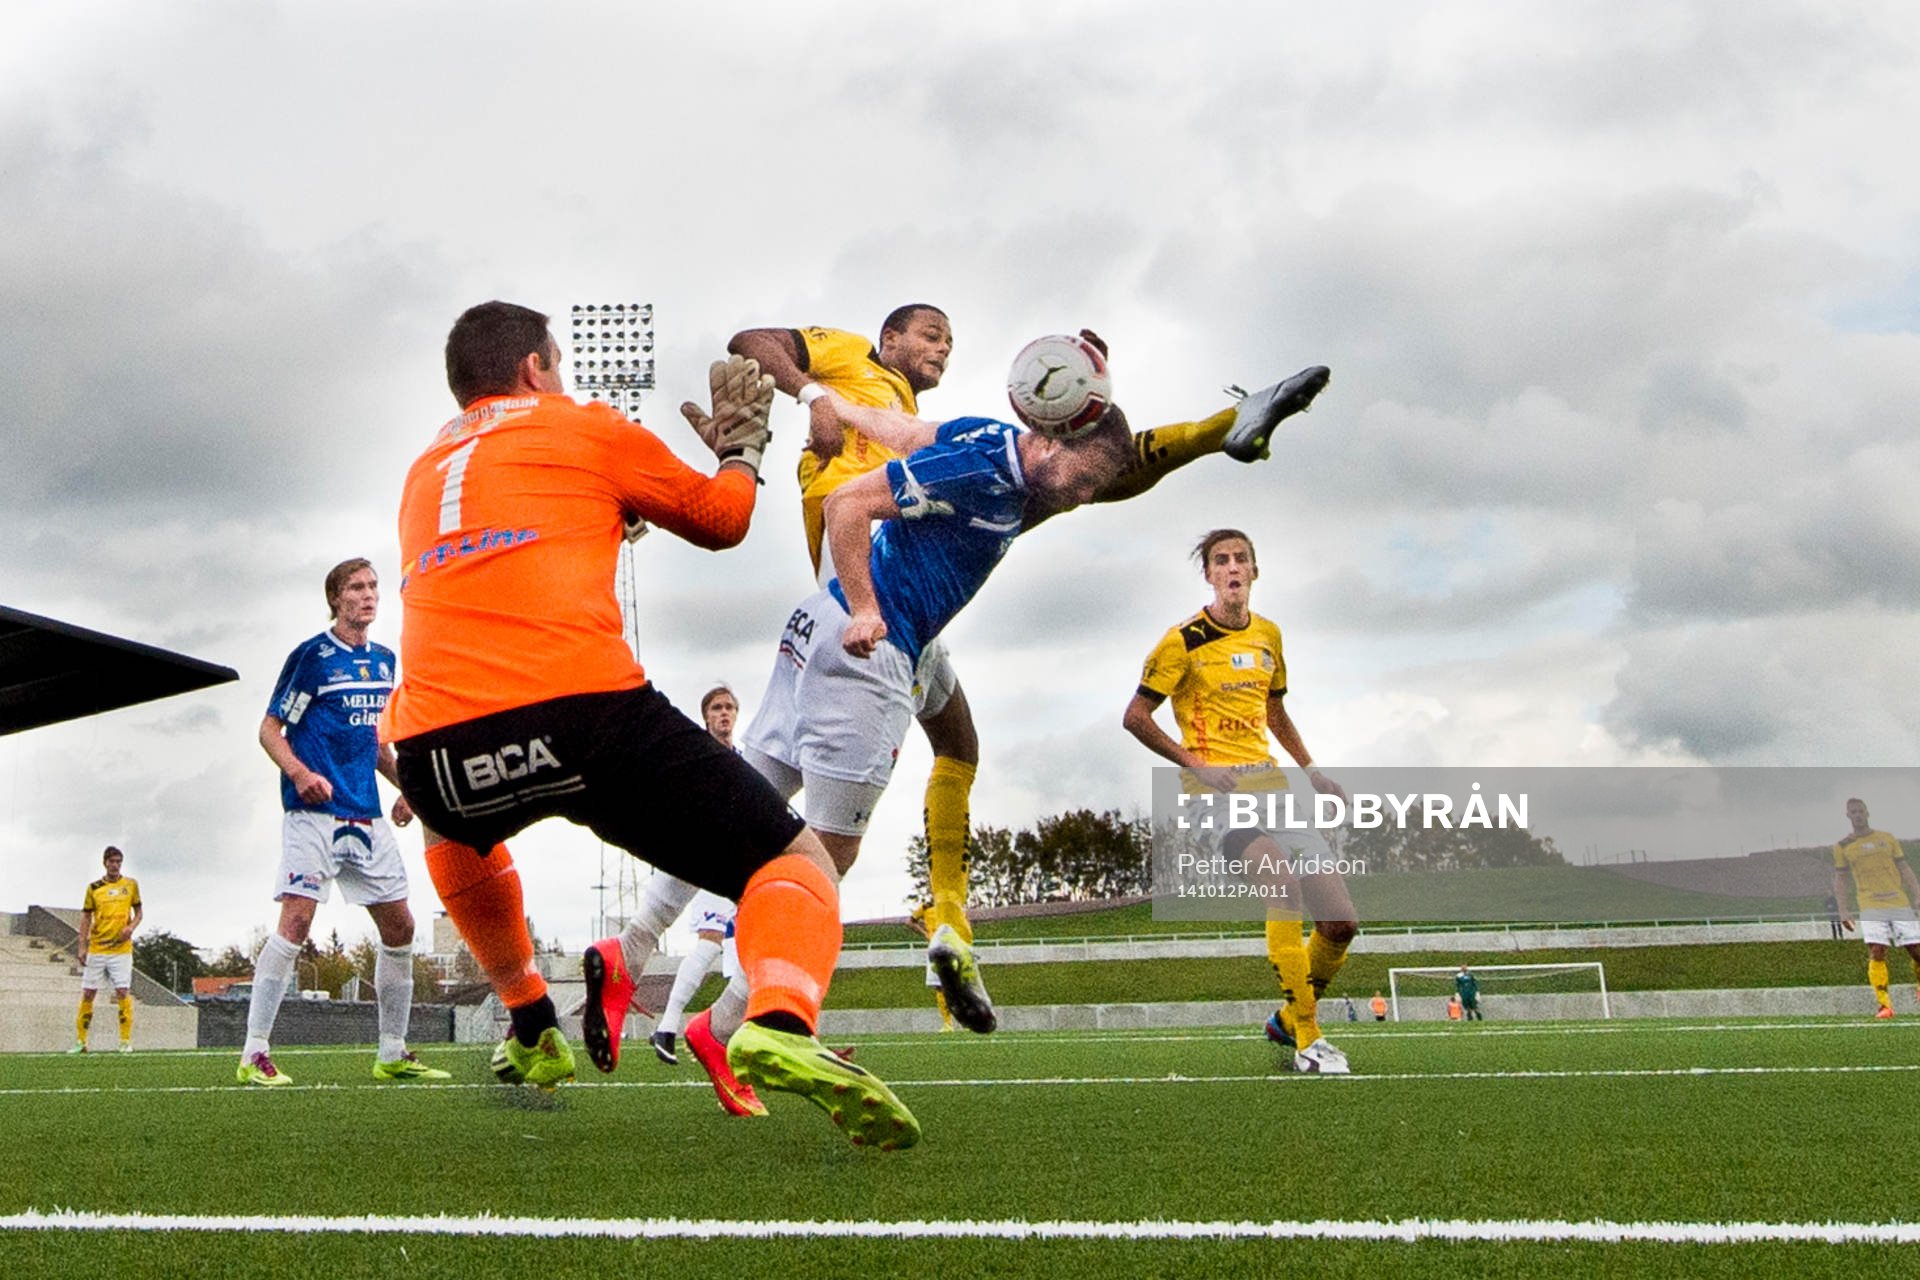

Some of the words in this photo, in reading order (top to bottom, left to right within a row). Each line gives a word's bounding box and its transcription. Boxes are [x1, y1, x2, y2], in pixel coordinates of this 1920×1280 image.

[437, 436, 480, 535] 1
[341, 694, 388, 708] MELLB
[462, 737, 561, 791] BCA
